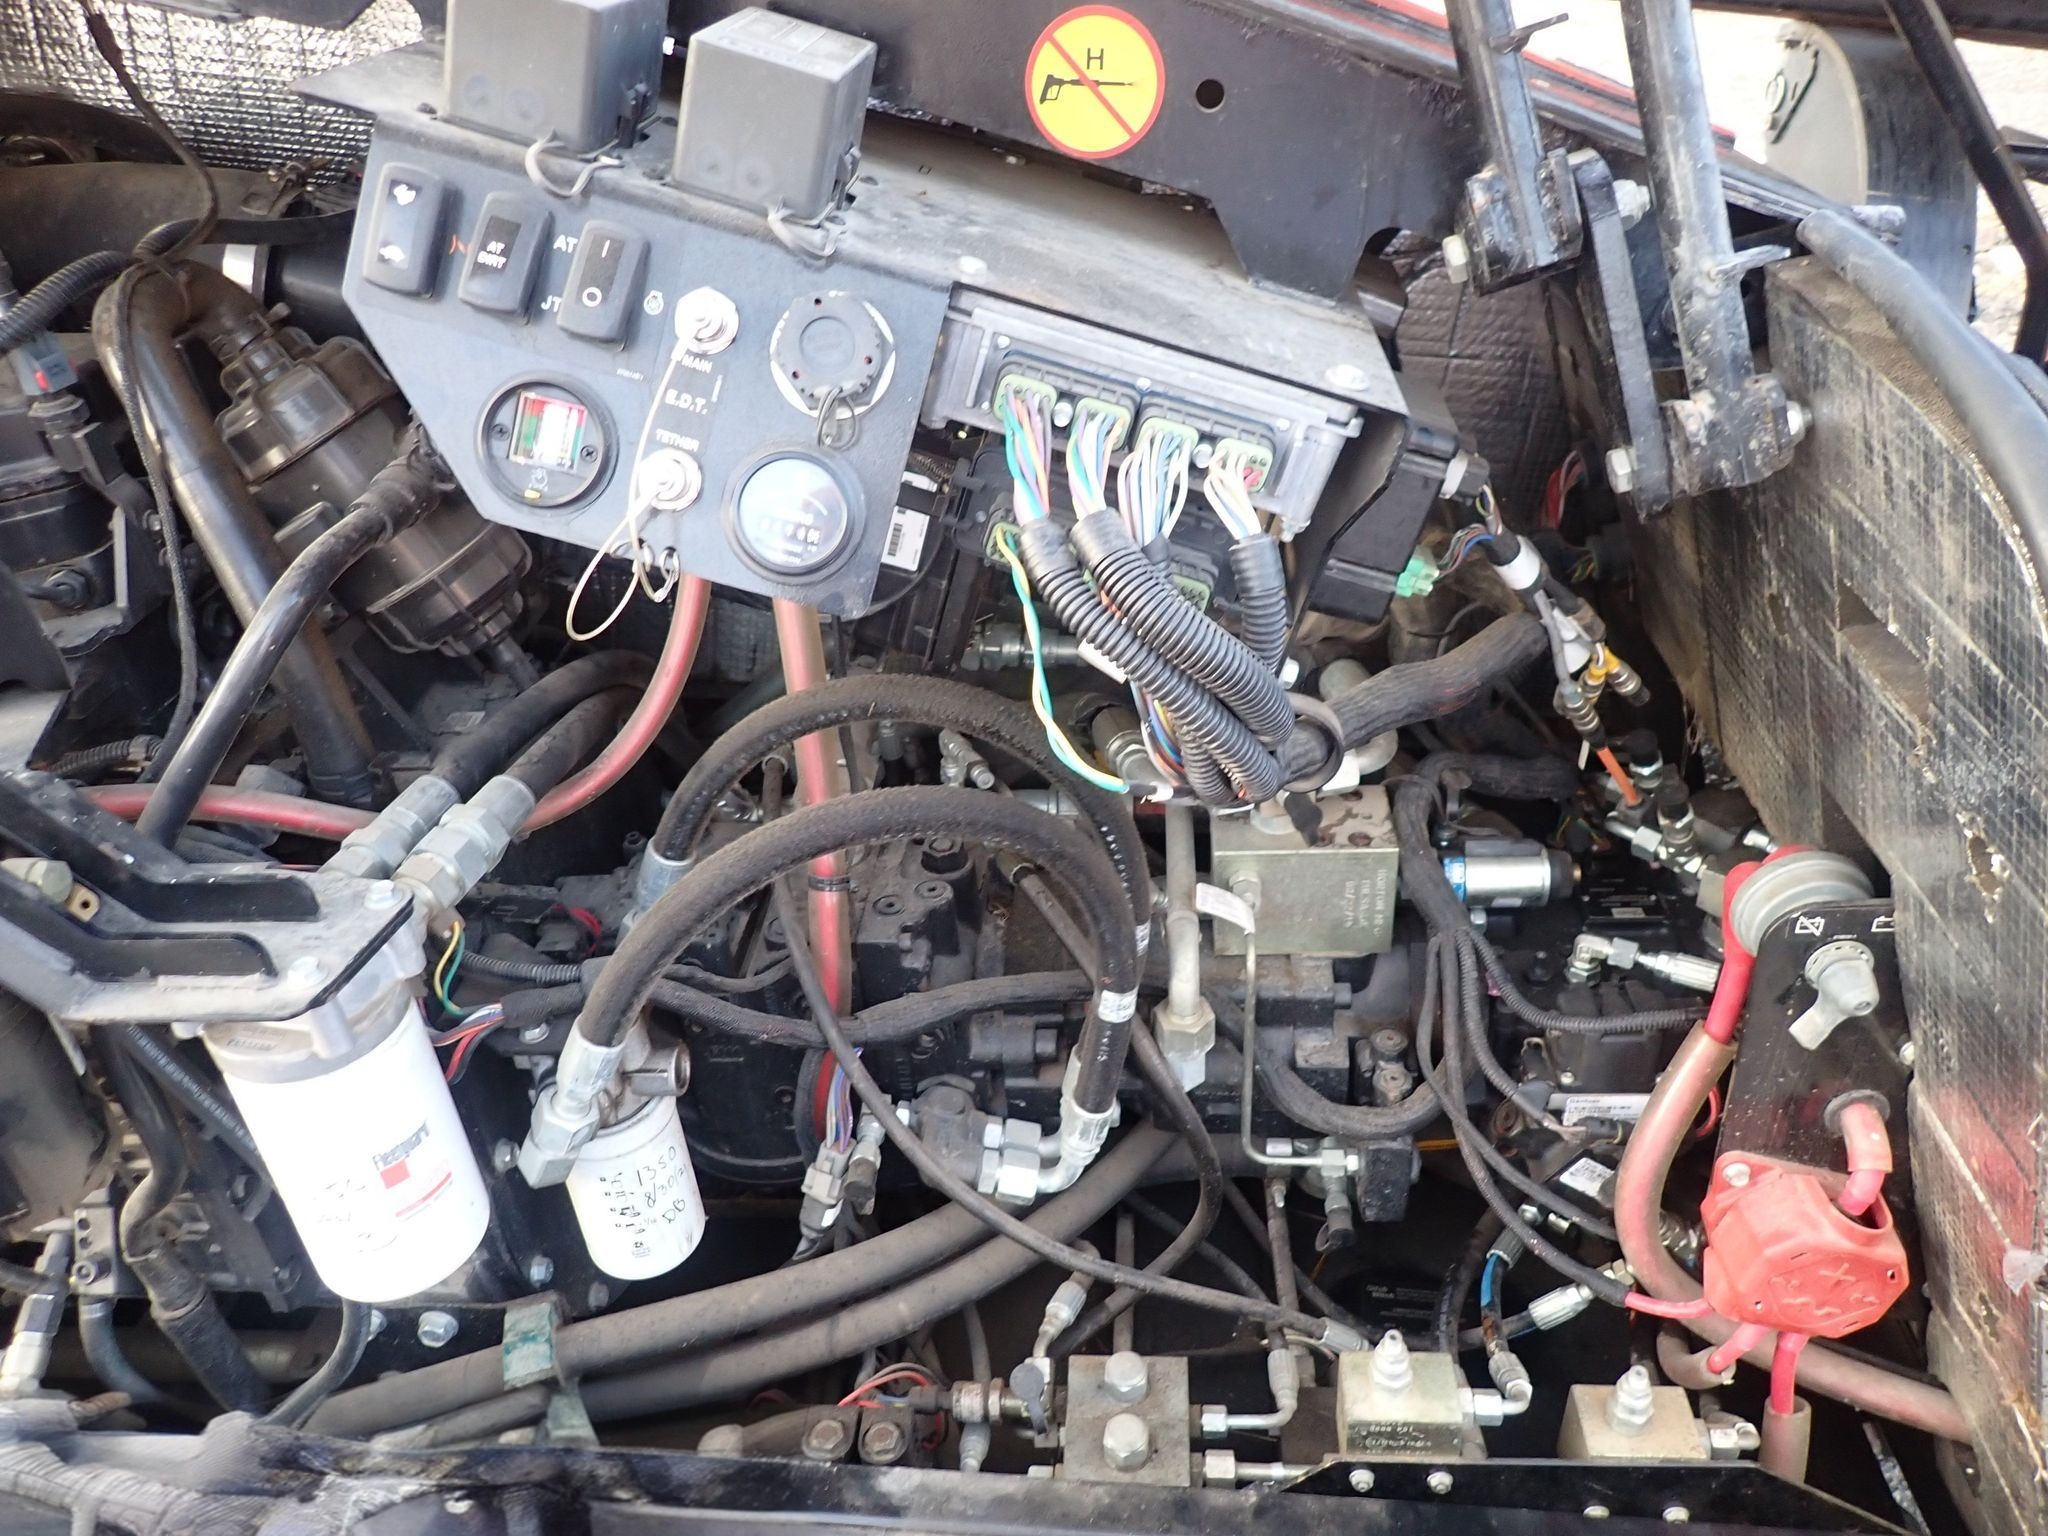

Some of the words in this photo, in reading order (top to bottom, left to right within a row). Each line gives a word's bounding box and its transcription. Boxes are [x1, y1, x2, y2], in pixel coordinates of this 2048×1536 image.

[1086, 47, 1104, 70] H
[553, 234, 579, 254] AT
[541, 295, 562, 313] JT
[681, 354, 713, 373] MAIN
[656, 428, 700, 453] TETHER
[637, 1145, 677, 1187] 1350
